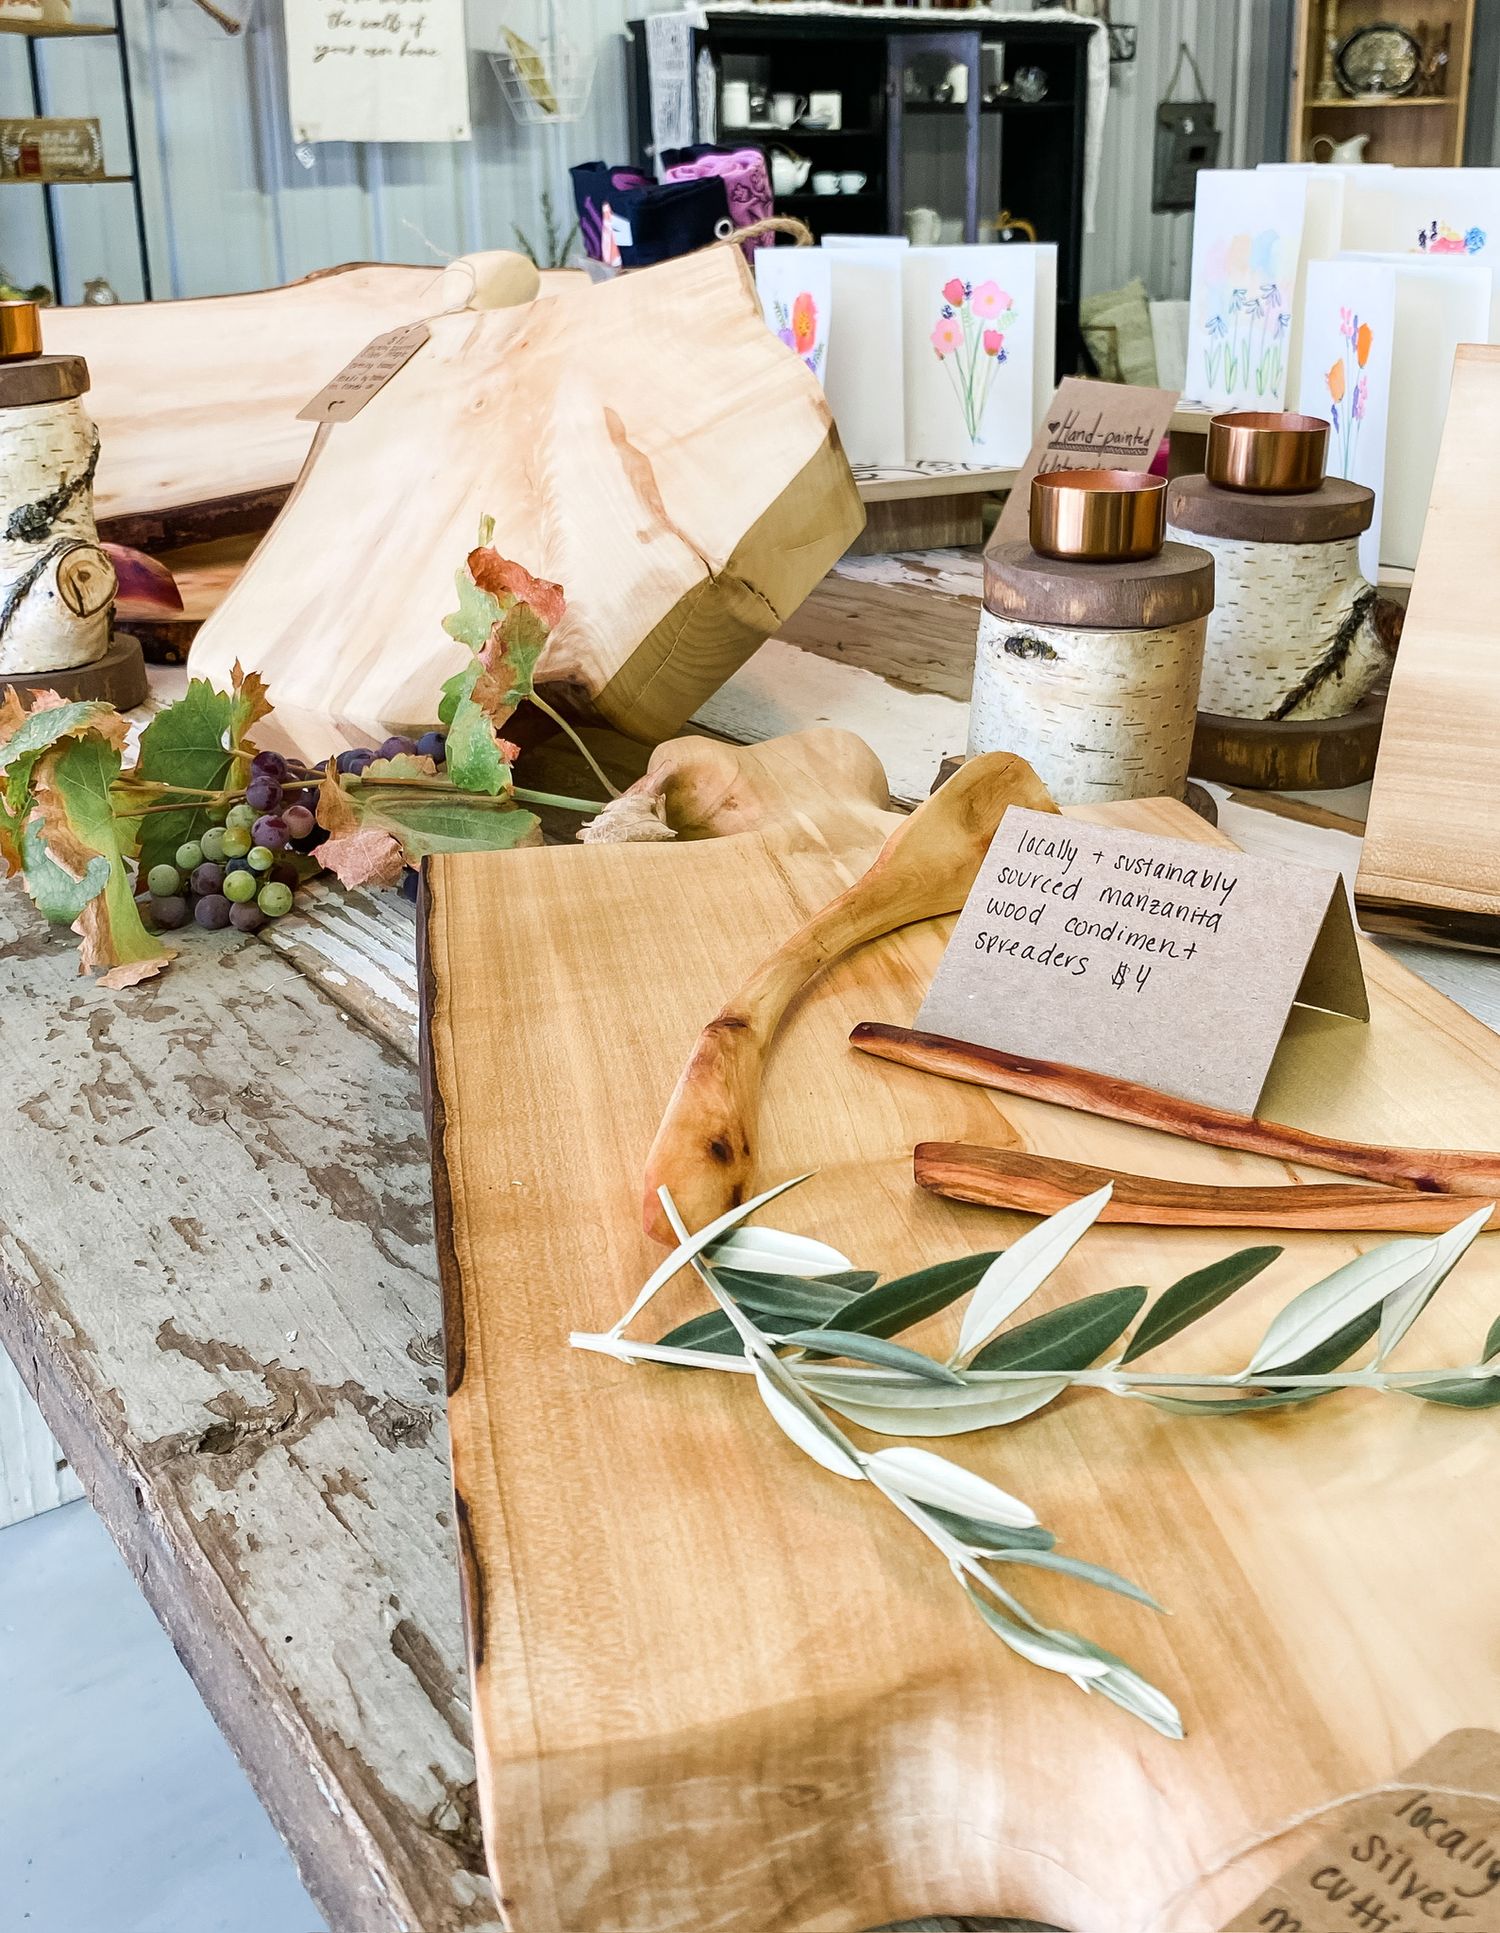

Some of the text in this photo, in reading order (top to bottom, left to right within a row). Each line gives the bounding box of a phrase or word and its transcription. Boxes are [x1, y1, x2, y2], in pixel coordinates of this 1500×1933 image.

[1056, 408, 1154, 457] Hand-painted
[998, 866, 1223, 933] sourced manzanita
[1018, 830, 1238, 905] locally + sustainably
[987, 898, 1198, 960] wood condiment
[974, 931, 1152, 993] spreaders $4
[1395, 1792, 1500, 1898] locally
